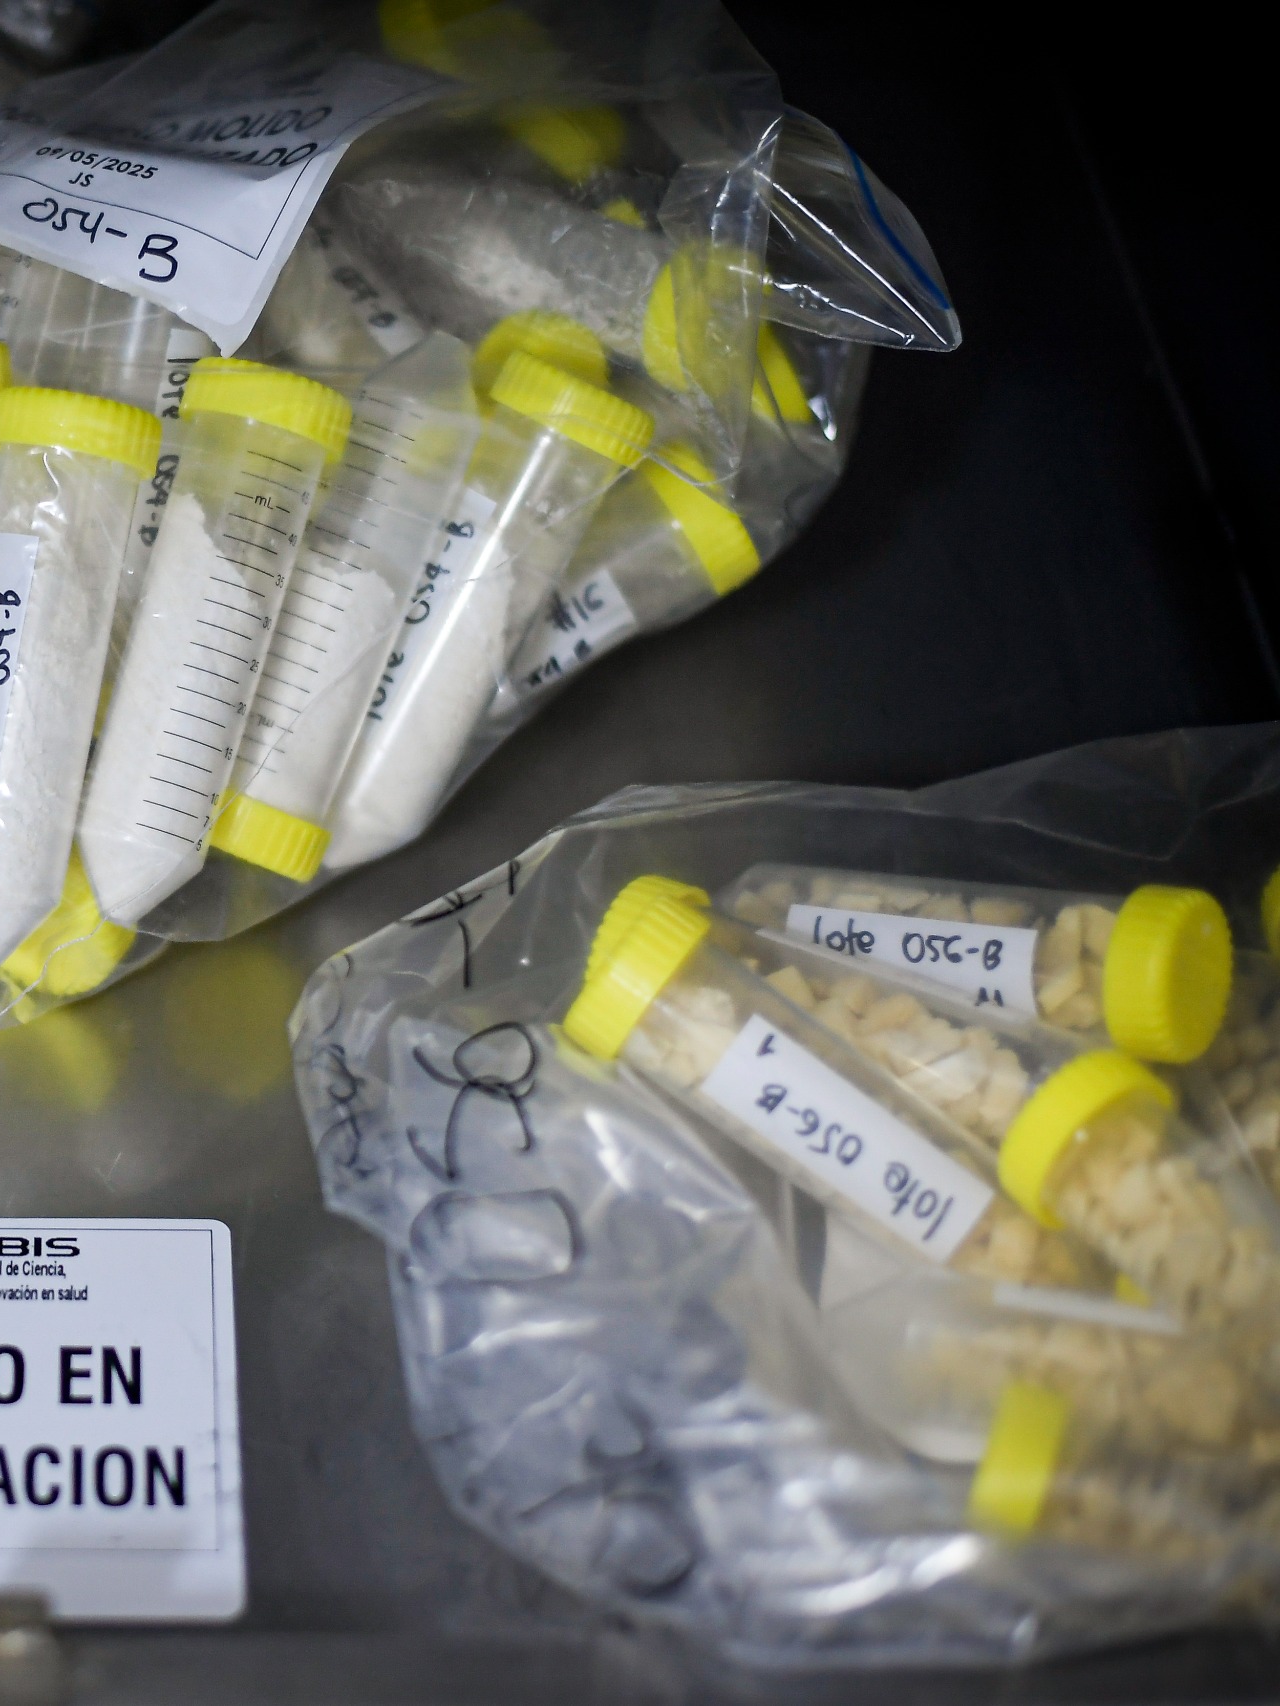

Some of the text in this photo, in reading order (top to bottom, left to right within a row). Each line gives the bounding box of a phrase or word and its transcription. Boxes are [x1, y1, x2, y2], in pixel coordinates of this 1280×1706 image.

[187, 105, 333, 142] MOLIDO
[36, 146, 159, 180] 09/05/2025
[68, 172, 95, 188] JS
[21, 197, 179, 284] 054-B
[253, 494, 275, 511] mL
[813, 914, 876, 957] lote
[754, 1082, 863, 1167] 056-B
[883, 1160, 954, 1242] lote
[5, 1260, 19, 1276] de
[22, 1260, 66, 1279] Ciencia,
[41, 1288, 55, 1301] en
[57, 1285, 89, 1301] salud
[58, 1345, 143, 1406] EN
